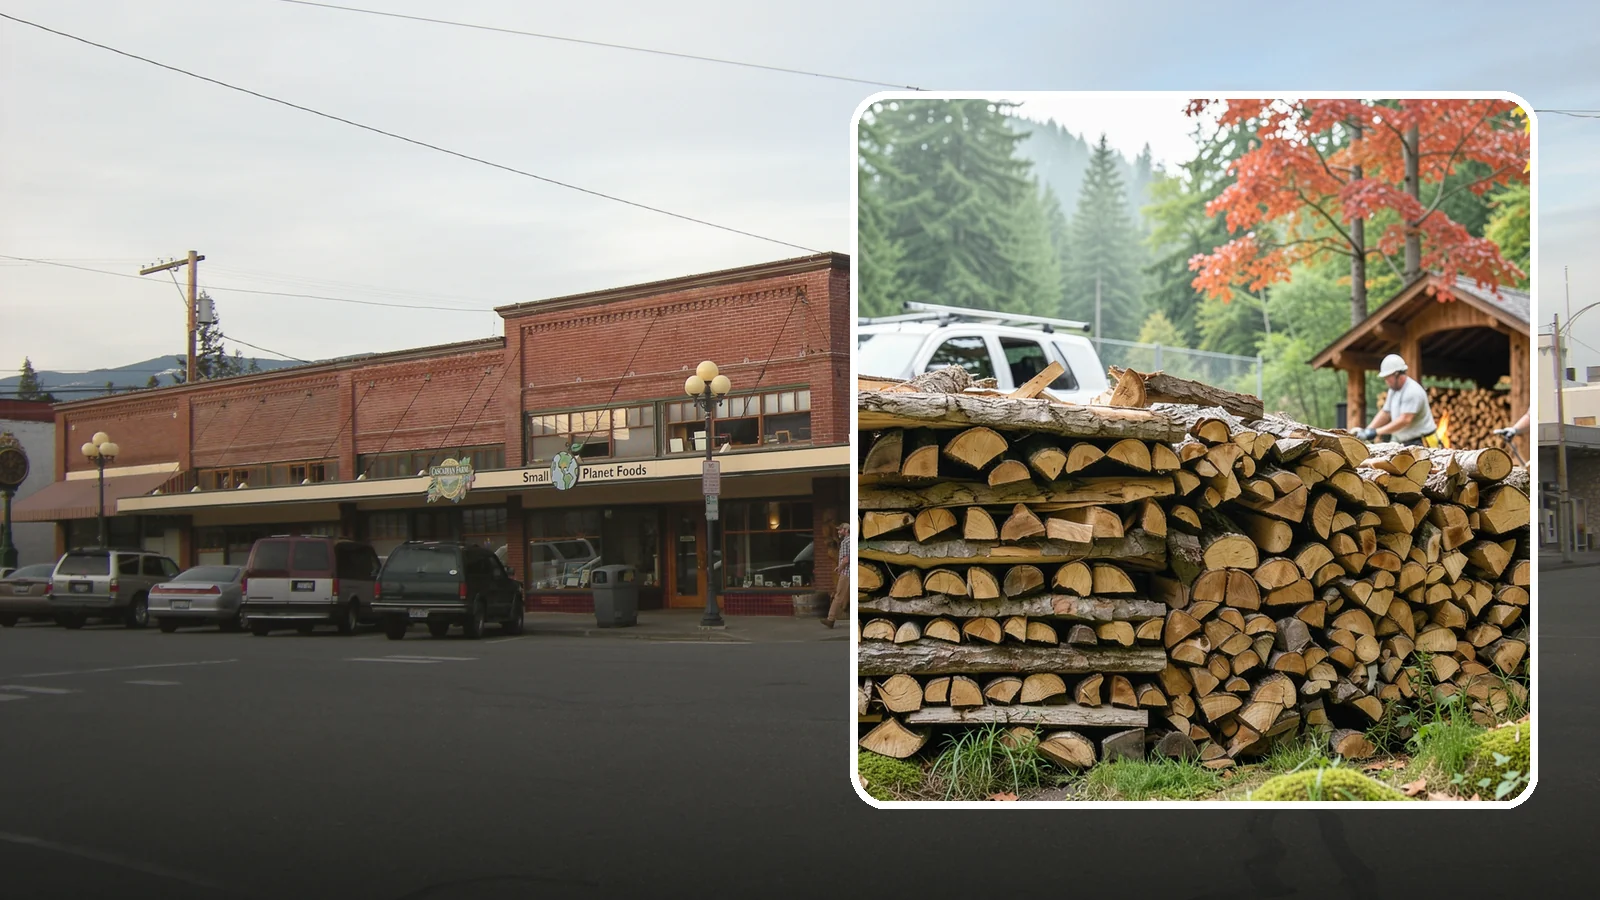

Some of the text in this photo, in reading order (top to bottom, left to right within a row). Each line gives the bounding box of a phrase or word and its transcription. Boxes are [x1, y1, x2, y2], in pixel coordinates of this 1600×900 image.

[523, 464, 647, 483] Small Planet Foods
